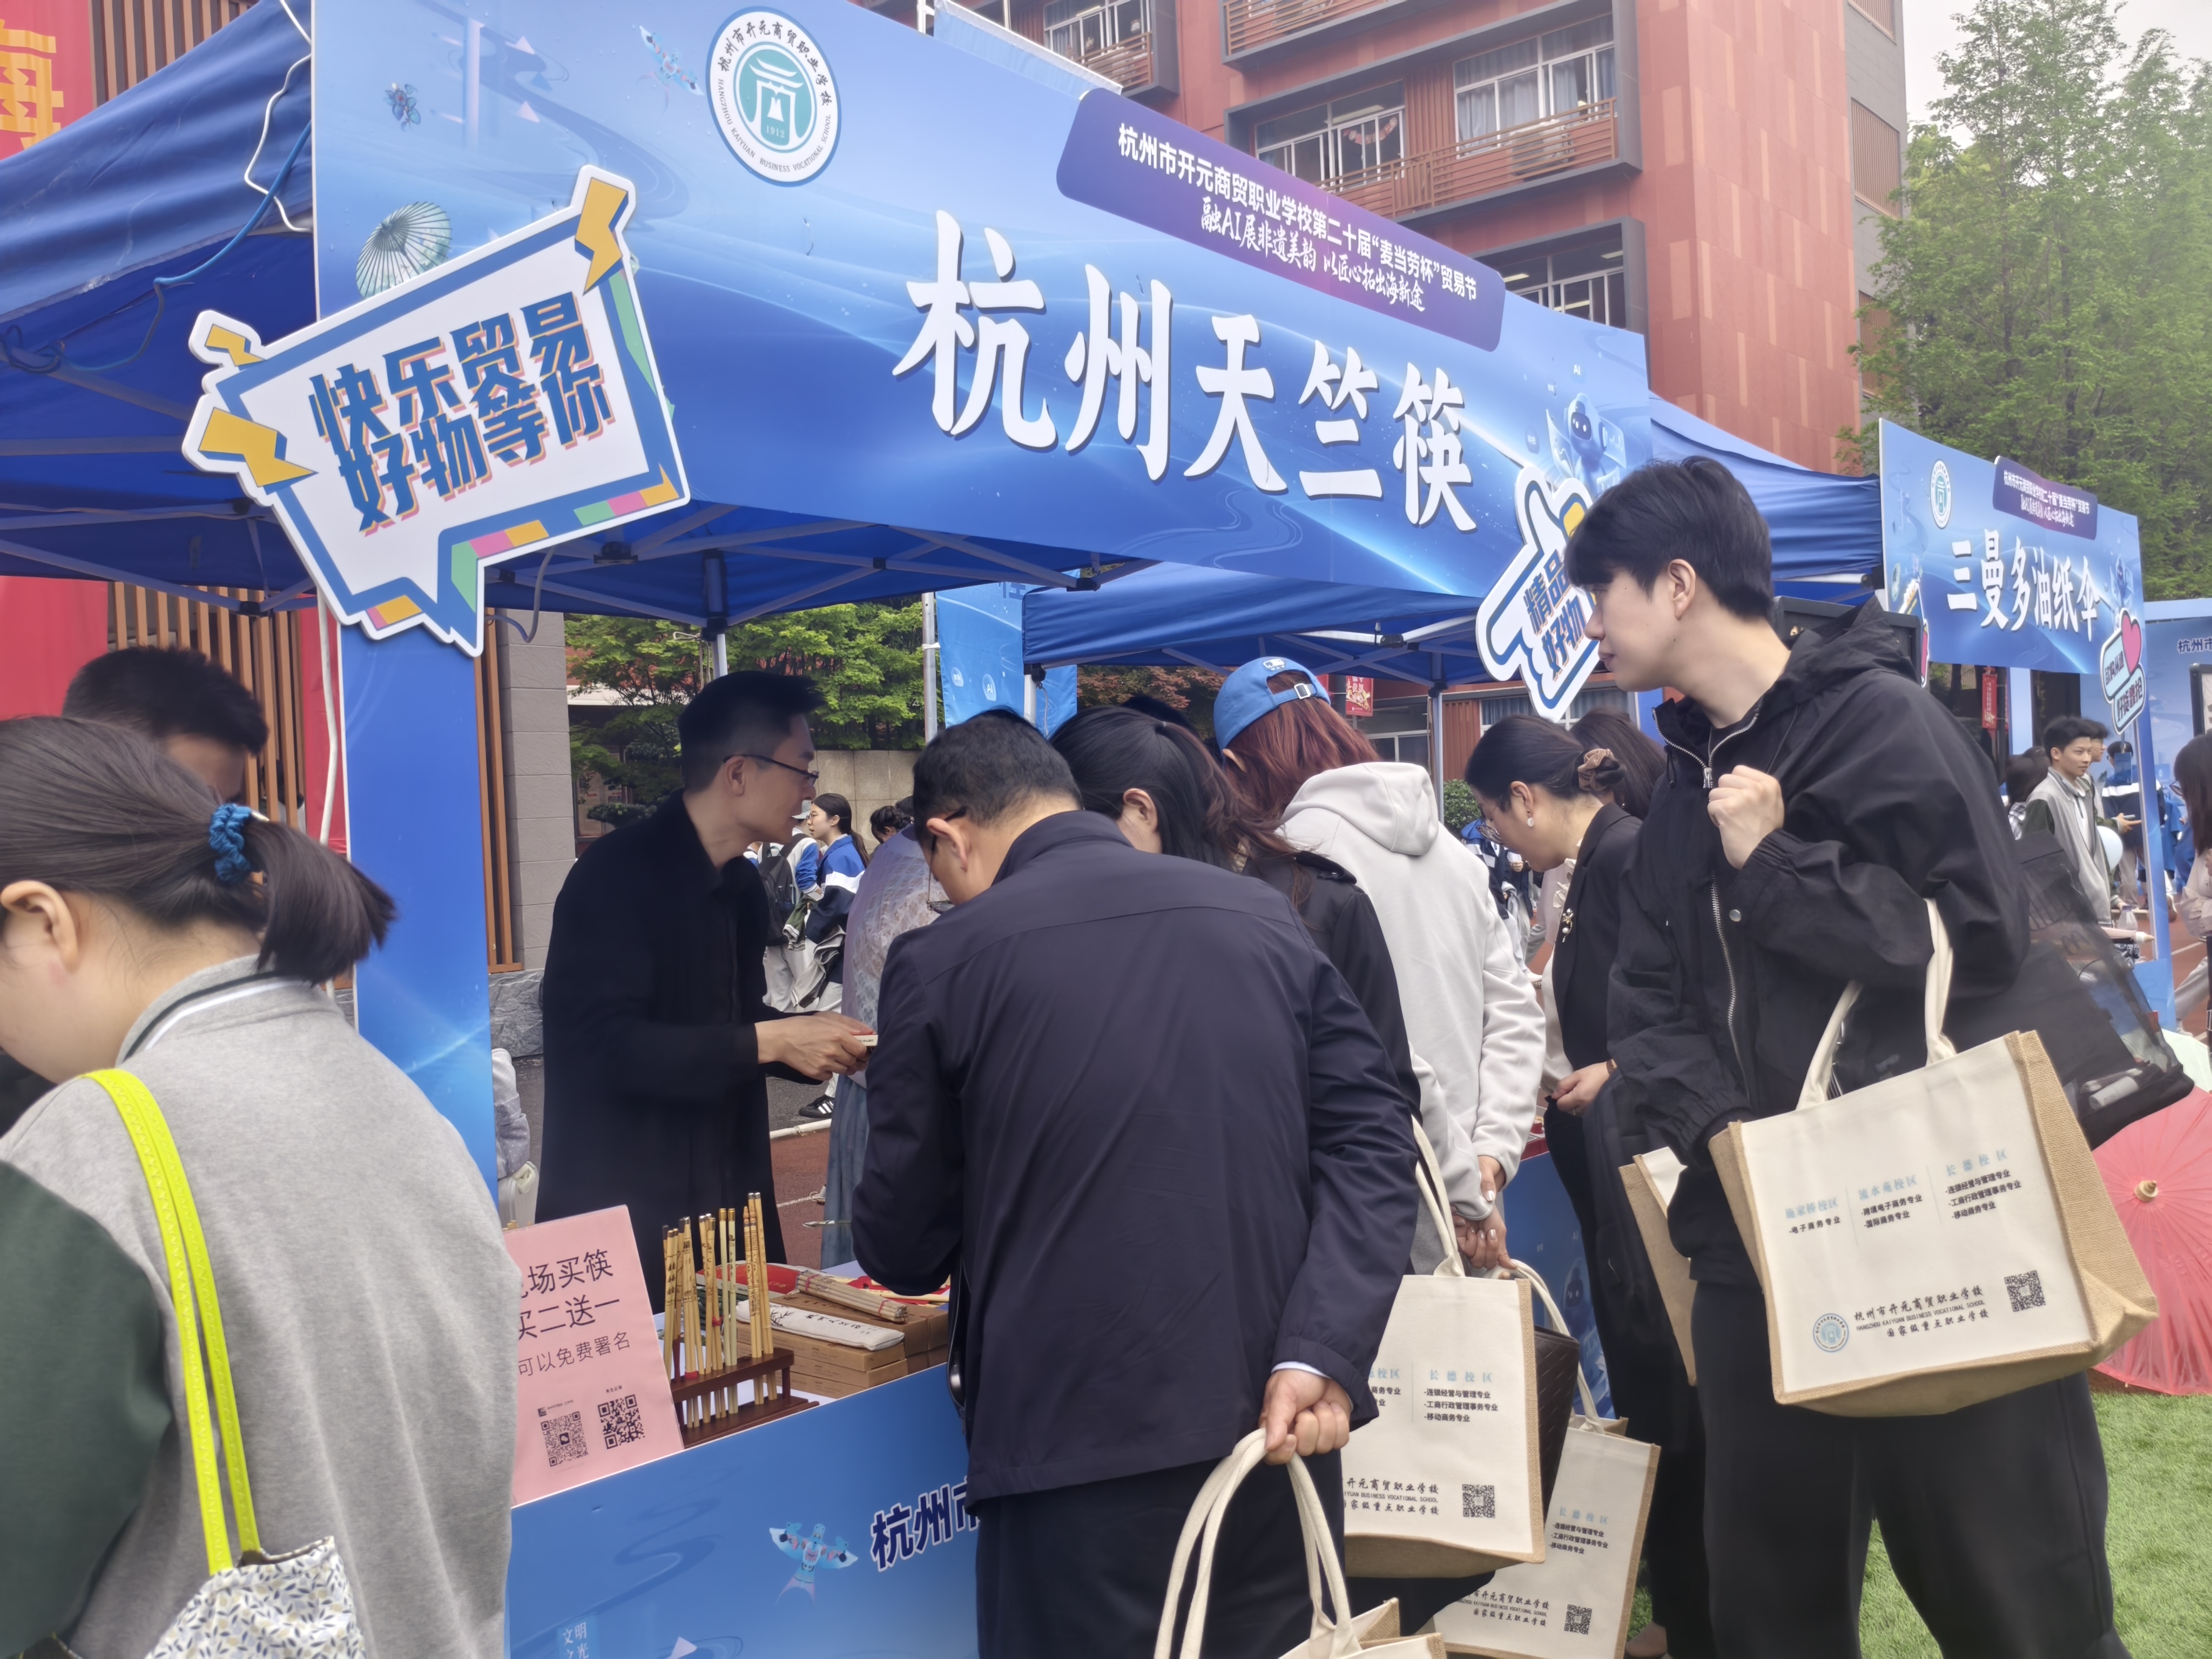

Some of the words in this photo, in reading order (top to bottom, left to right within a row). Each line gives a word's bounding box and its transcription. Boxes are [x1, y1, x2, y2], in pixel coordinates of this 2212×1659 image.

[717, 20, 833, 107] 杭州市开元商贸职业学校
[718, 78, 733, 125] HANGZHOU
[731, 127, 756, 158] KAIYUAN
[759, 157, 790, 173] BUSINESS
[793, 145, 824, 172] VOCATIONAL
[821, 114, 832, 144] SCHOOL
[765, 125, 785, 139] 1912
[1323, 251, 1426, 312] 以匠心拓出海新途
[309, 291, 596, 453] 快乐贸易
[892, 209, 1479, 533] 杭州天竺筷
[336, 363, 616, 536] 好物等你
[1523, 549, 1574, 636] 精品
[1947, 529, 2100, 643] 三曼多油纸伞
[1541, 595, 1587, 683] 好物
[987, 683, 994, 694] AI
[521, 1249, 613, 1299] 场买筷
[518, 1294, 620, 1341] 买二送一
[1853, 1285, 1984, 1321] 杭州市开元商贸职业学校
[1856, 1319, 1880, 1331] HANGZHOU
[1882, 1317, 1905, 1327] KAIYUAN
[1907, 1311, 1931, 1321] BUSINESS
[1933, 1305, 1965, 1316] VOCATIONAL
[1966, 1299, 1986, 1309] SCHOOL
[518, 1331, 631, 1377] 可以免费署名
[1429, 1369, 1493, 1383] 长德校区
[1343, 1477, 1439, 1494] 开元商贸职业学校
[1343, 1499, 1439, 1515] 家级重点职业学校
[1361, 1492, 1385, 1500] BUSINESS
[1387, 1494, 1418, 1502] VOCATIONAL
[1467, 1589, 1550, 1610] 市开元商贸职业学校
